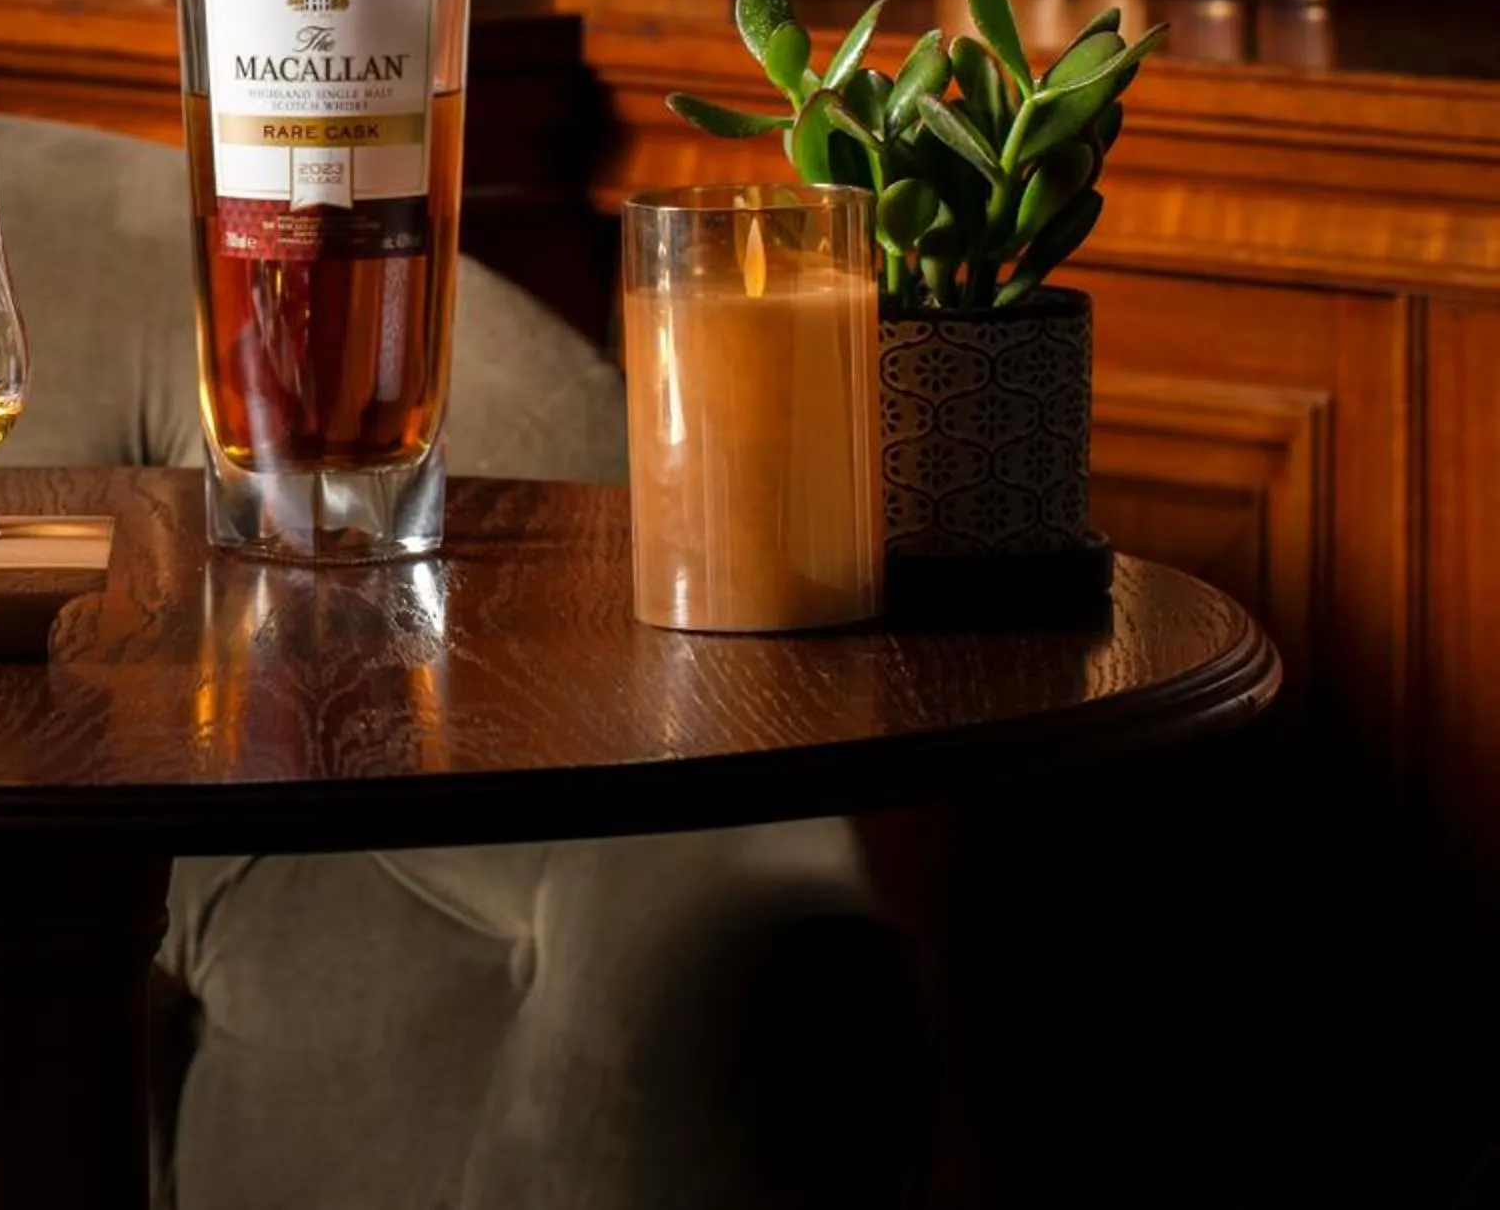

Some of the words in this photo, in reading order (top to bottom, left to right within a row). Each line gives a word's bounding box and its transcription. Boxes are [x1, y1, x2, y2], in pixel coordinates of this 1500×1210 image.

[291, 25, 336, 53] The
[235, 54, 410, 82] MACALLAN
[364, 87, 394, 99] MALT
[272, 101, 319, 111] SCOTCH
[263, 125, 318, 140] RARE
[324, 124, 379, 140] CASK
[298, 162, 344, 175] 2023
